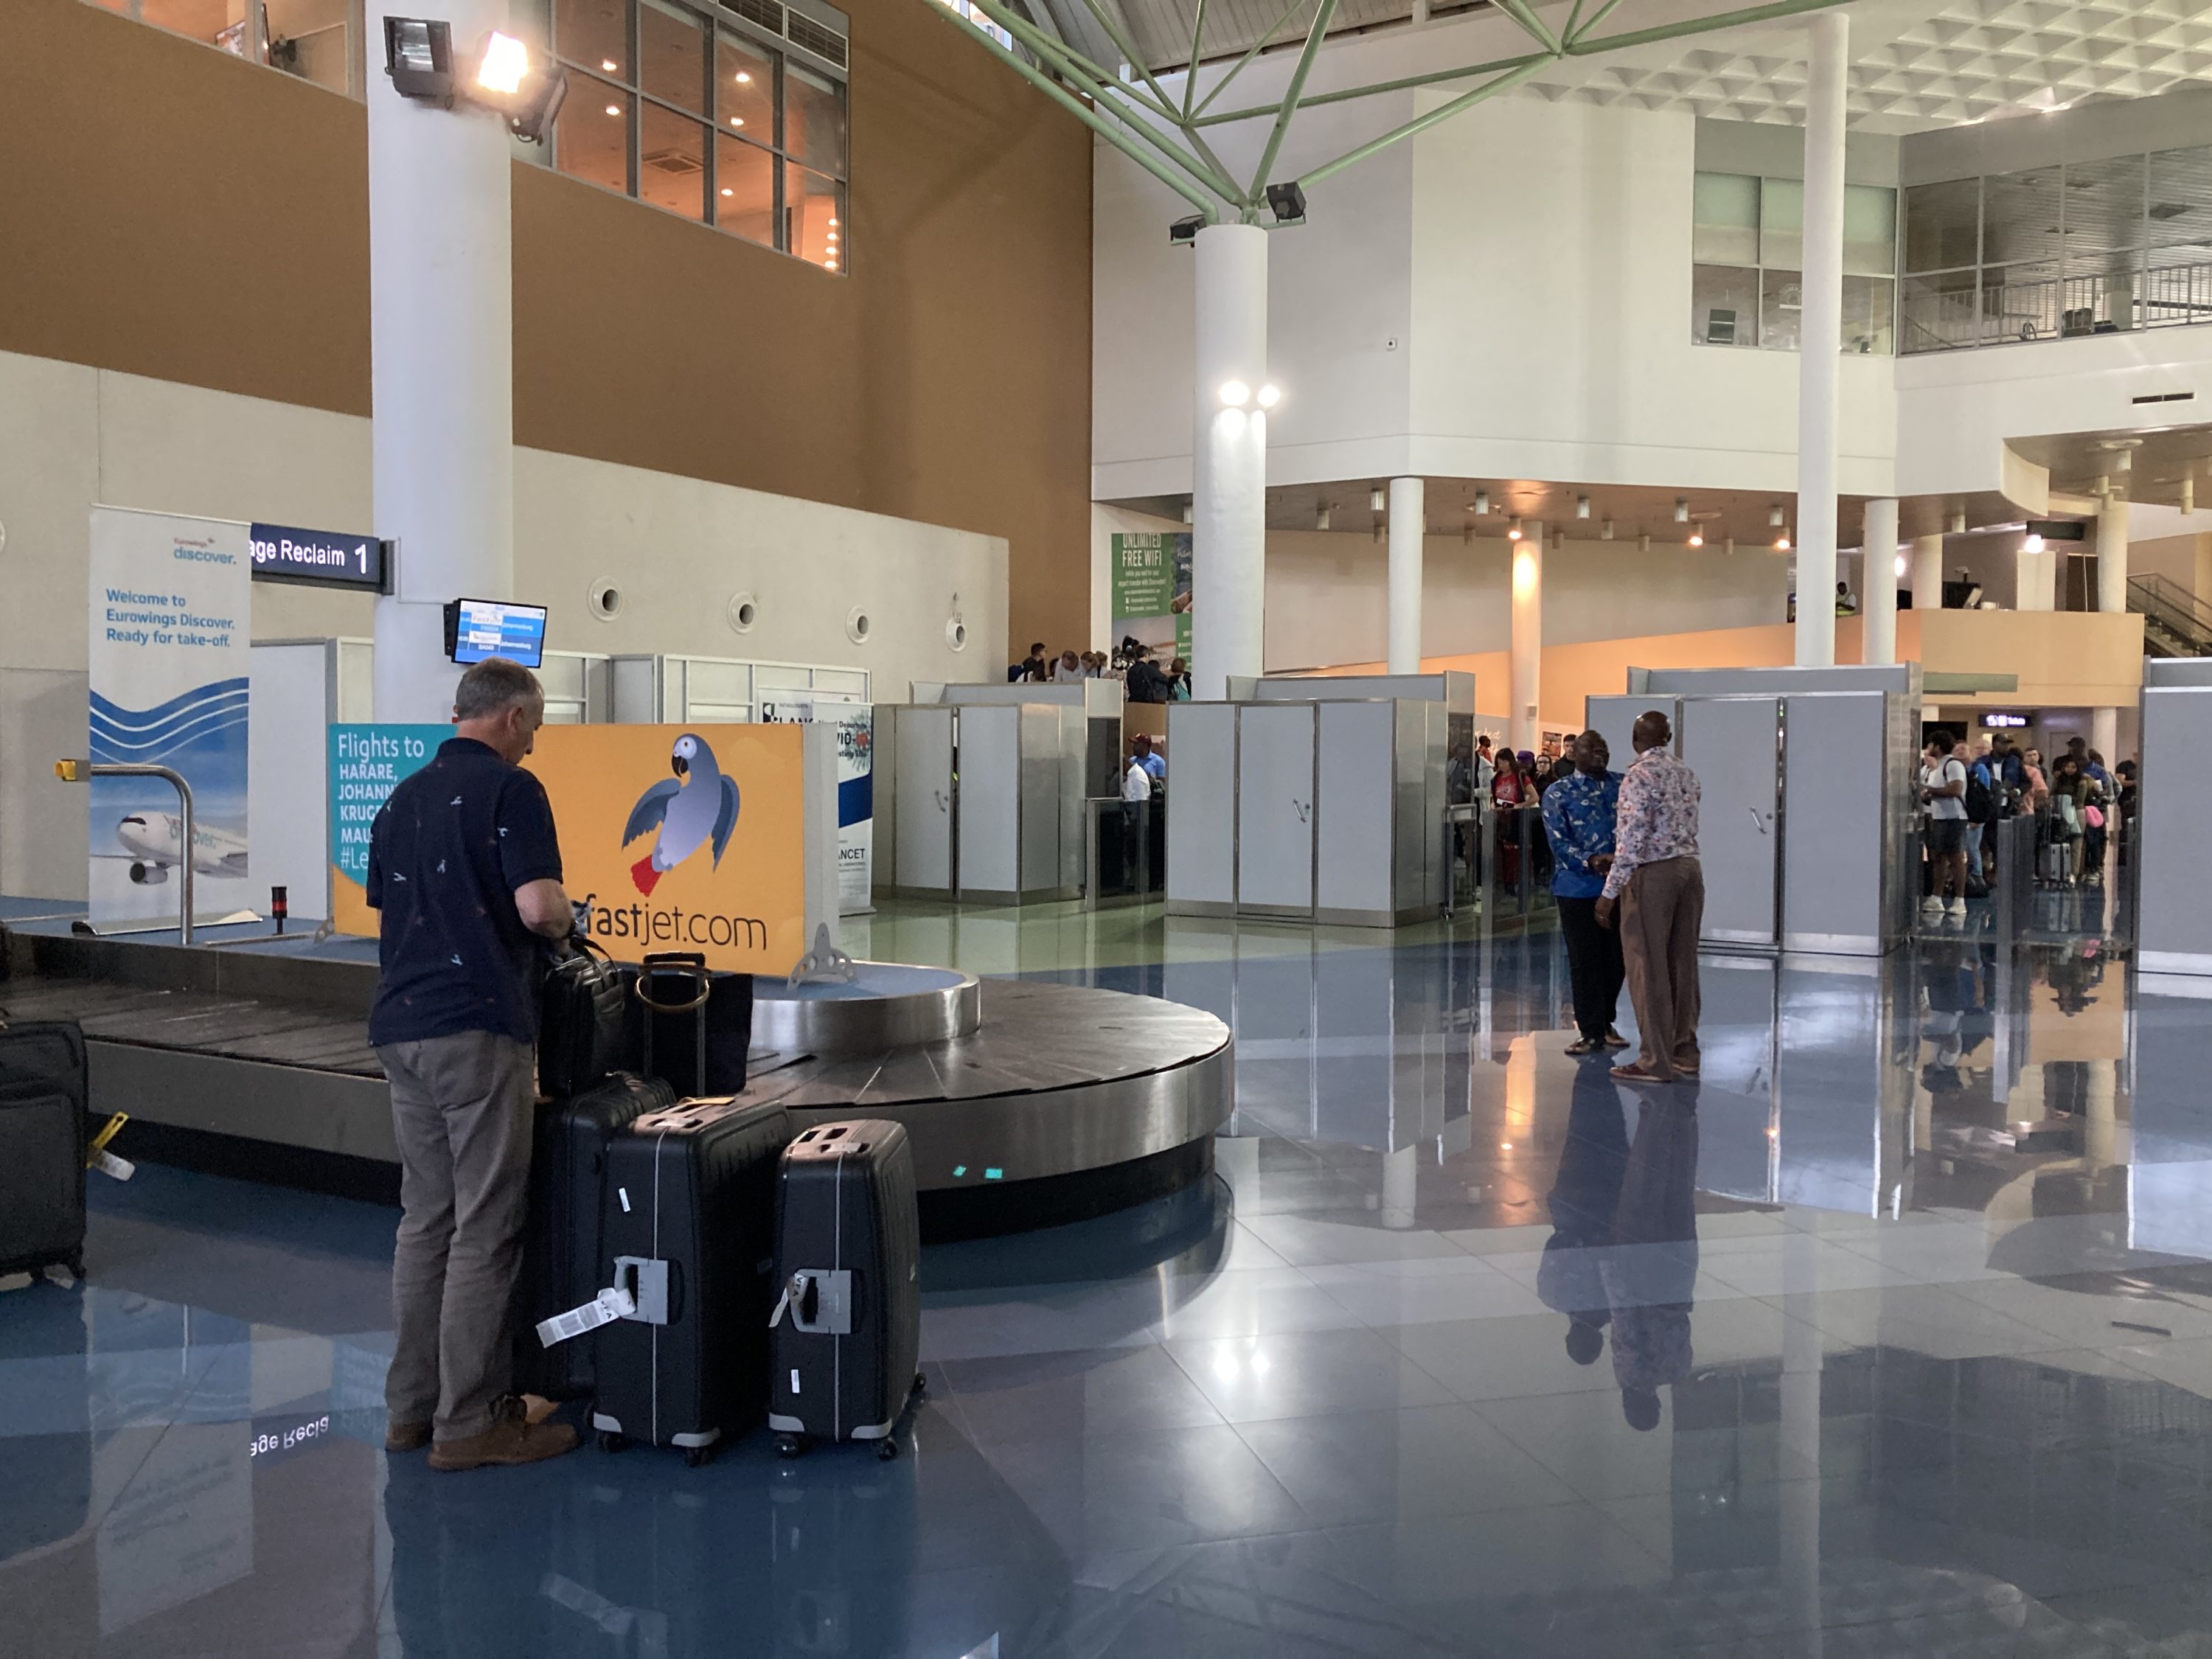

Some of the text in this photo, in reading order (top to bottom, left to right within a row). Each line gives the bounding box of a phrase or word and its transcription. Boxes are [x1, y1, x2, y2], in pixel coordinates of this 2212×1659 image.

[1123, 533, 1161, 548] UNLIMITED
[174, 547, 237, 565] discover.
[281, 540, 345, 566] Reclaim
[355, 544, 366, 574] 1
[1123, 549, 1142, 567] FREE
[1144, 549, 1162, 567] WIFI
[106, 589, 186, 607] Welcome to
[106, 609, 235, 630] Eurowings Discover.
[107, 628, 231, 647] Ready for take-off.
[338, 732, 425, 764] Flights to
[339, 764, 398, 782] HARARE,
[338, 784, 397, 800] JOHANN
[341, 847, 369, 869] #Le
[586, 894, 767, 950] fastjet.com
